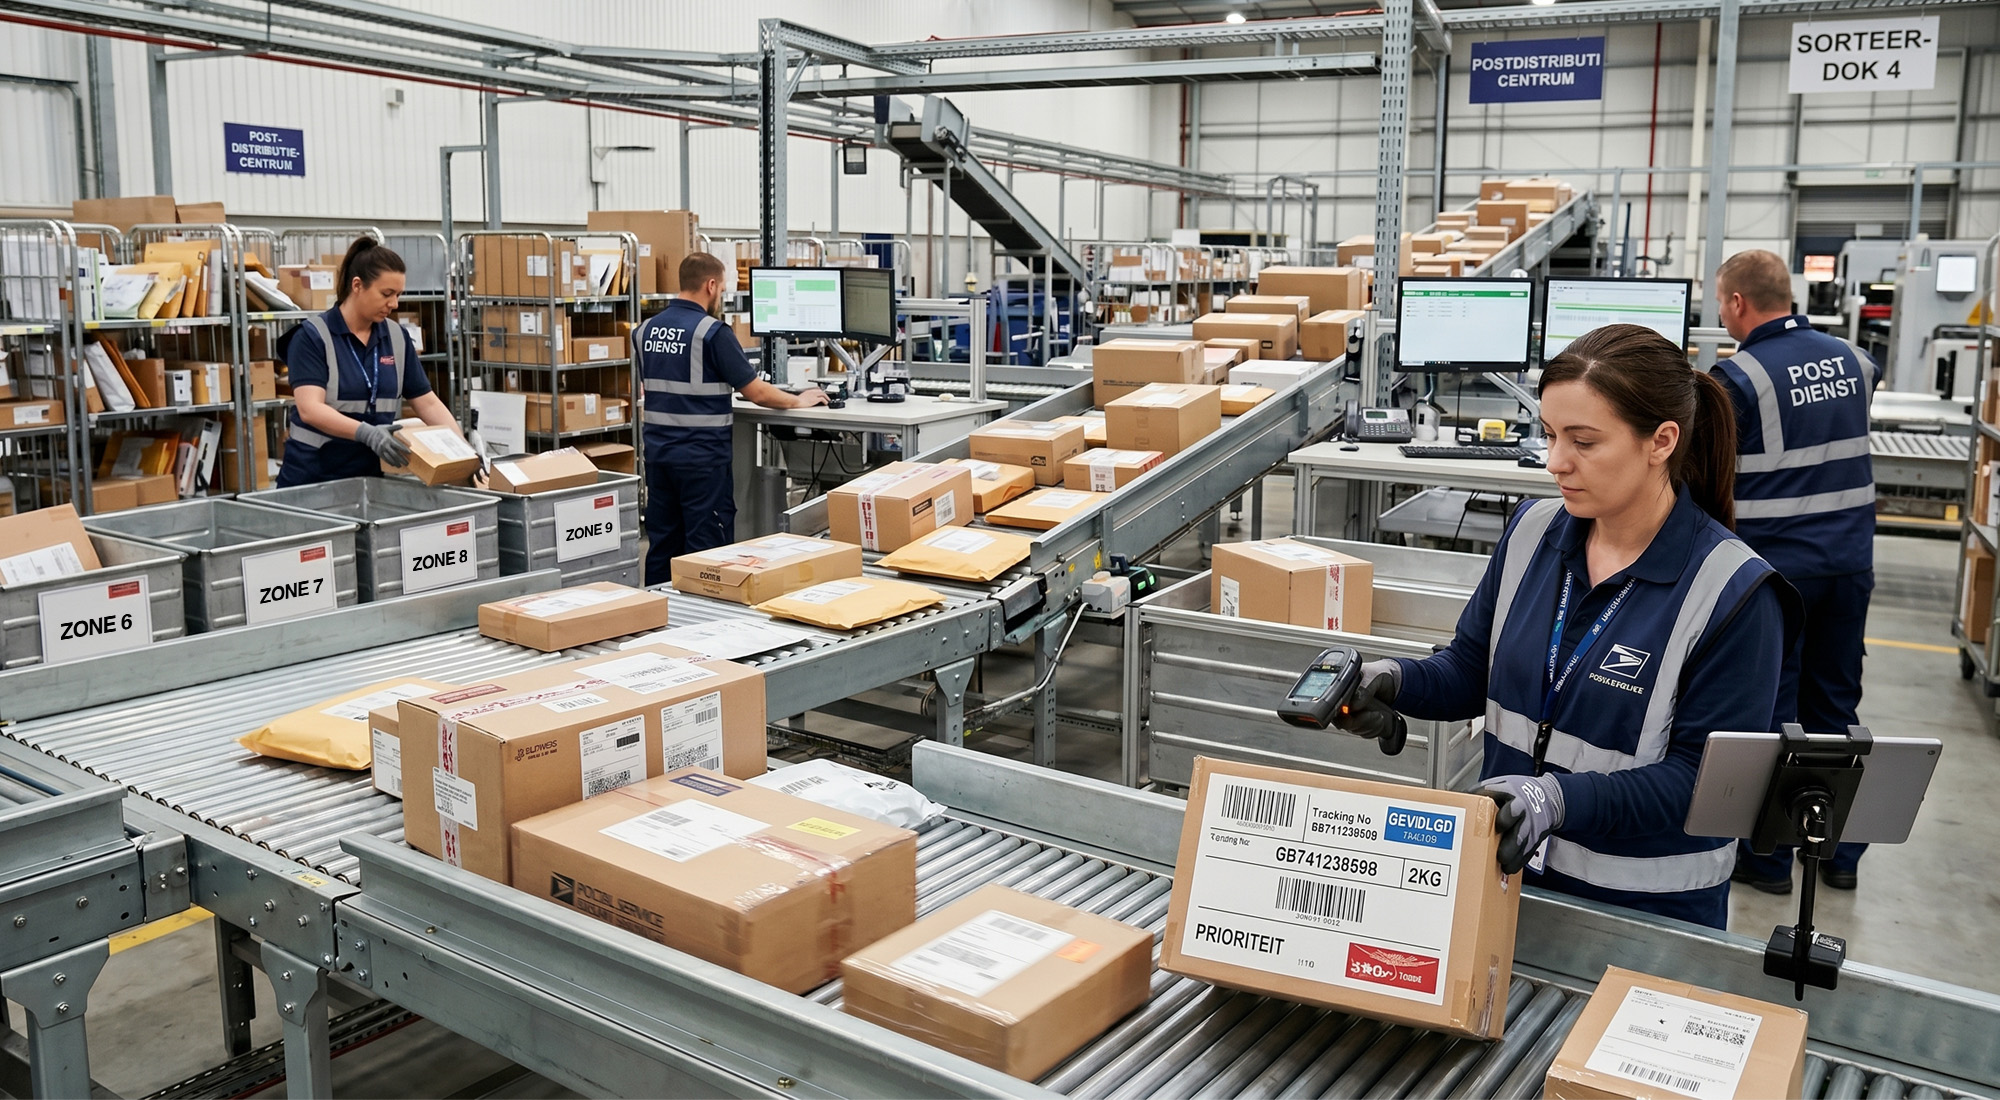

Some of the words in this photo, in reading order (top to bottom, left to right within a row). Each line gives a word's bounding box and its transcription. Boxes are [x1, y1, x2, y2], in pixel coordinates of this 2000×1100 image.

[1797, 29, 1932, 53] SORTEER-
[1471, 53, 1601, 71] POSTDISTRIBUTI
[1822, 60, 1879, 81] DOK
[1886, 60, 1901, 79] 4
[1497, 72, 1575, 88] CENTRUM
[249, 131, 283, 143] POST-
[239, 157, 293, 170] CENTRUM
[649, 326, 686, 341] POST
[644, 340, 687, 355] DIENST
[1787, 356, 1845, 385] POST
[1790, 377, 1858, 407] DIENST
[565, 522, 602, 542] ZONE
[605, 521, 613, 534] 9
[412, 550, 456, 572] ZONE
[458, 549, 468, 563] 8
[260, 580, 309, 605] ZONE
[313, 577, 324, 594] 7
[60, 614, 117, 641] ZONE
[121, 613, 133, 630] 6
[1312, 807, 1355, 825] Tracking
[1357, 813, 1372, 825] No
[1275, 846, 1378, 876] GB741238598
[1408, 868, 1442, 887] 2KG
[1195, 923, 1286, 956] PRIORITEIT
